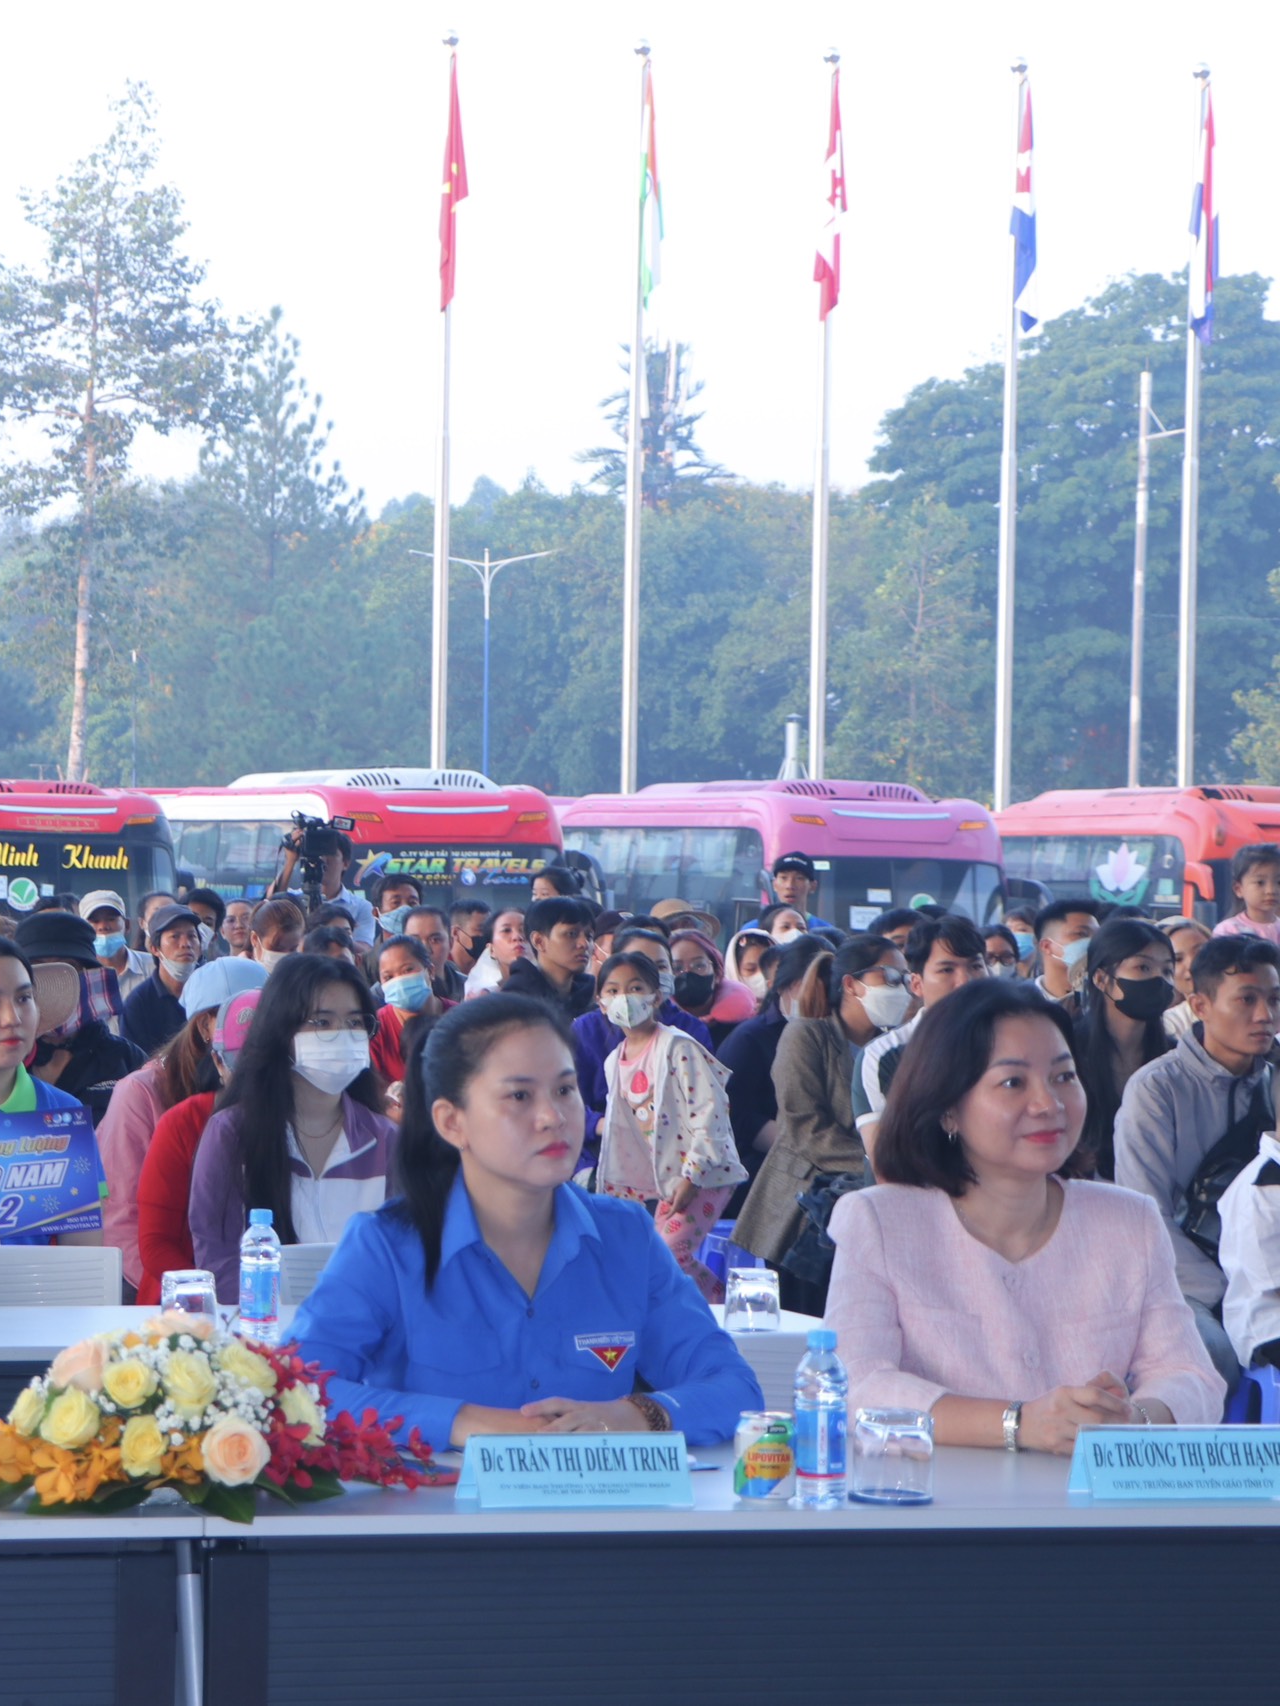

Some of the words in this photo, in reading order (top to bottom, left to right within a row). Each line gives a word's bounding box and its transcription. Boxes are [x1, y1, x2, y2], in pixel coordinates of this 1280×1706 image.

[384, 858, 447, 874] STAR
[452, 858, 546, 874] TRAVELS
[4, 1158, 70, 1190] NAM
[506, 1439, 550, 1472] TRẦN
[552, 1447, 583, 1478] THỊ
[585, 1438, 628, 1472] DIỄM
[629, 1446, 681, 1472] TRINH
[1115, 1439, 1176, 1468] TRƯƠNG
[1177, 1442, 1206, 1474] THỊ
[1206, 1434, 1241, 1466] BÍCH
[1243, 1442, 1280, 1474] HẠNH
